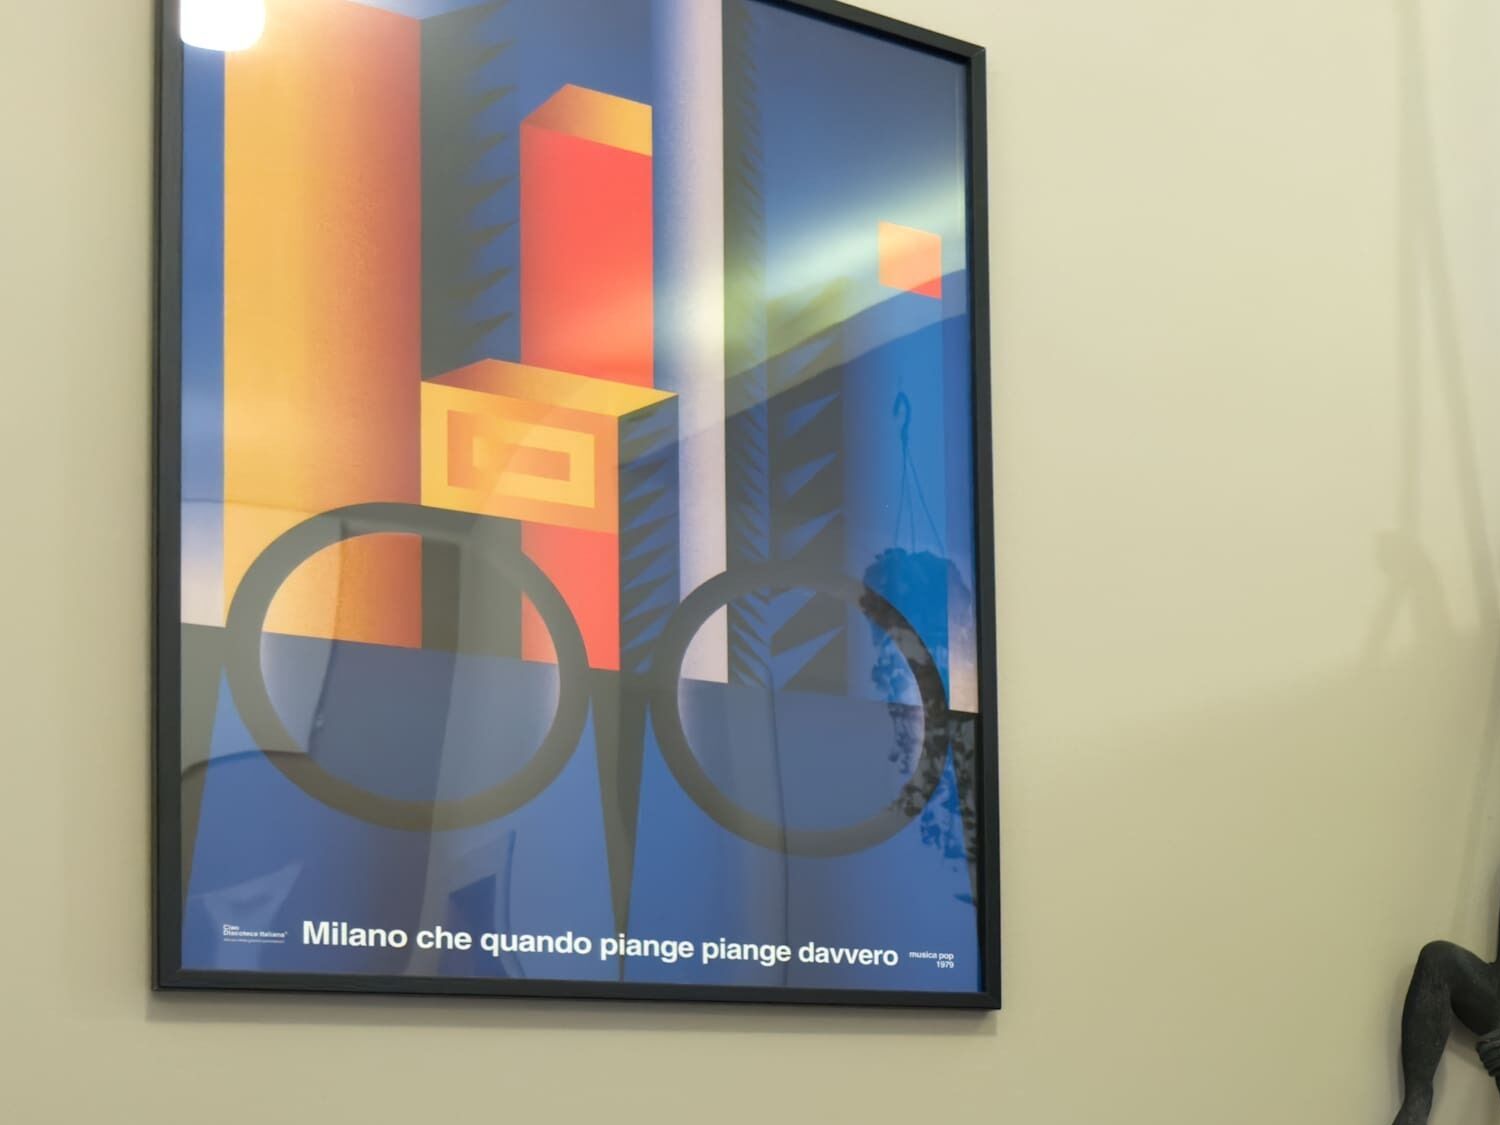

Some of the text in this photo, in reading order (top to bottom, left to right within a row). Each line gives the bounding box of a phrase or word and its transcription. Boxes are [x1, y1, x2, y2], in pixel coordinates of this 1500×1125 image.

[302, 920, 899, 967] Milano che quando piange piange davvero
[909, 951, 954, 961] musica pop
[936, 960, 955, 969] 1979
